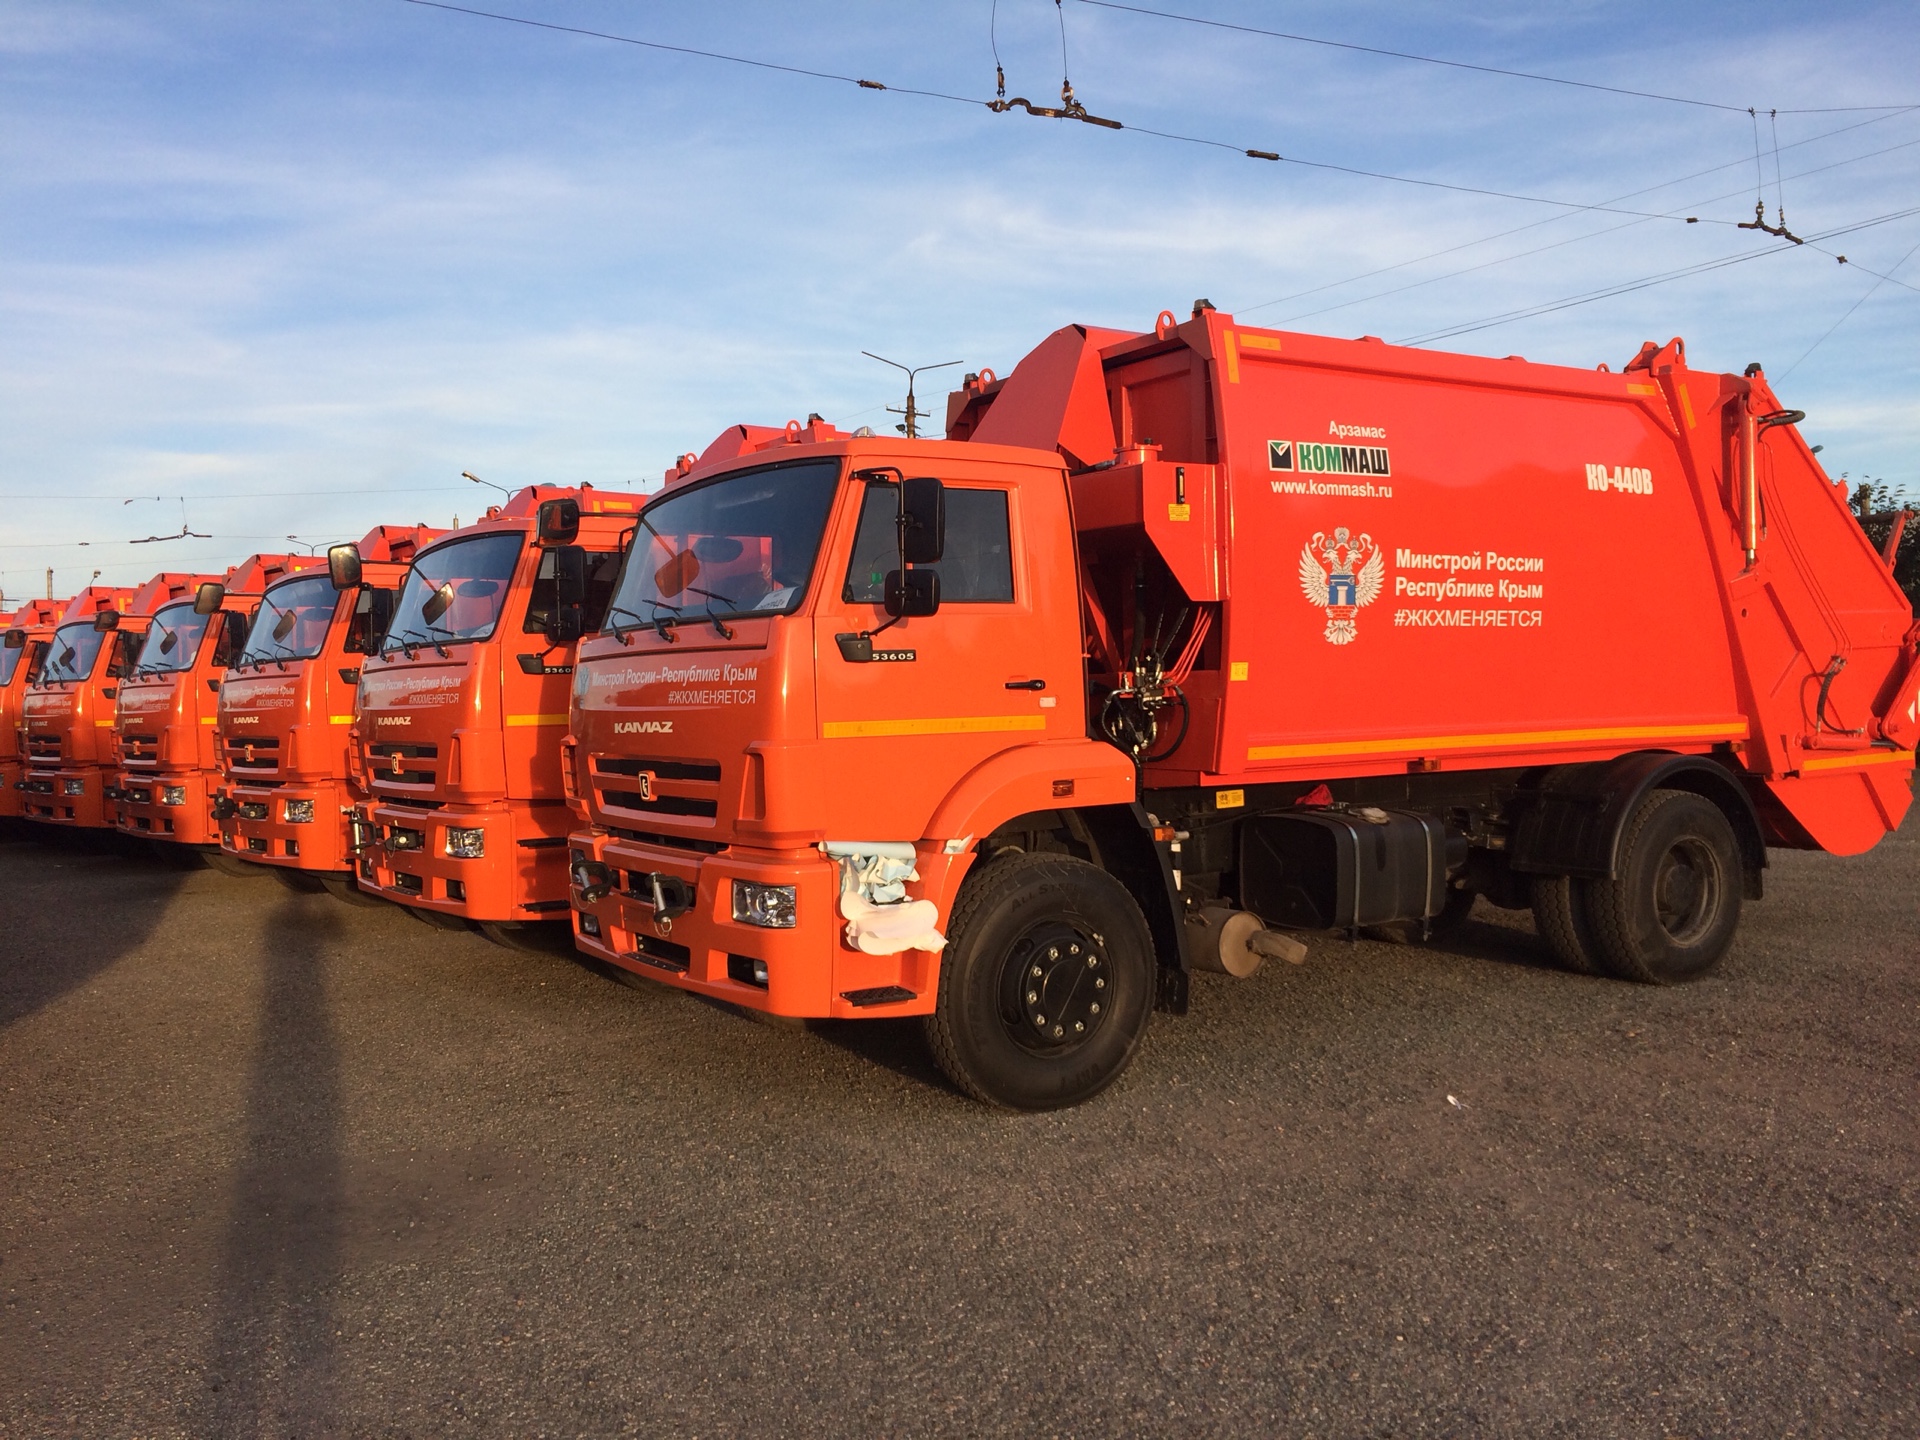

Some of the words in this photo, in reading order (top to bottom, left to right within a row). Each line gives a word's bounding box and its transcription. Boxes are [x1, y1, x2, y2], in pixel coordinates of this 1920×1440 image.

[1329, 420, 1386, 439] Арзамас
[1298, 443, 1389, 475] КОММАШ
[1271, 479, 1393, 498] www.kommash.ru
[1585, 463, 1654, 495] КО-440В
[1396, 548, 1482, 574] Минстрой
[1486, 551, 1544, 572] России
[1395, 576, 1495, 602] Республике
[1499, 579, 1543, 603] Крым
[1394, 609, 1543, 627] #ЖКХМЕНЯЕТСЯ
[723, 664, 758, 685] Крым
[668, 689, 756, 704] #ЖКХМЕНЯЕТСЯ
[378, 716, 412, 726] KAMAZ
[614, 721, 673, 734] KAMAZ
